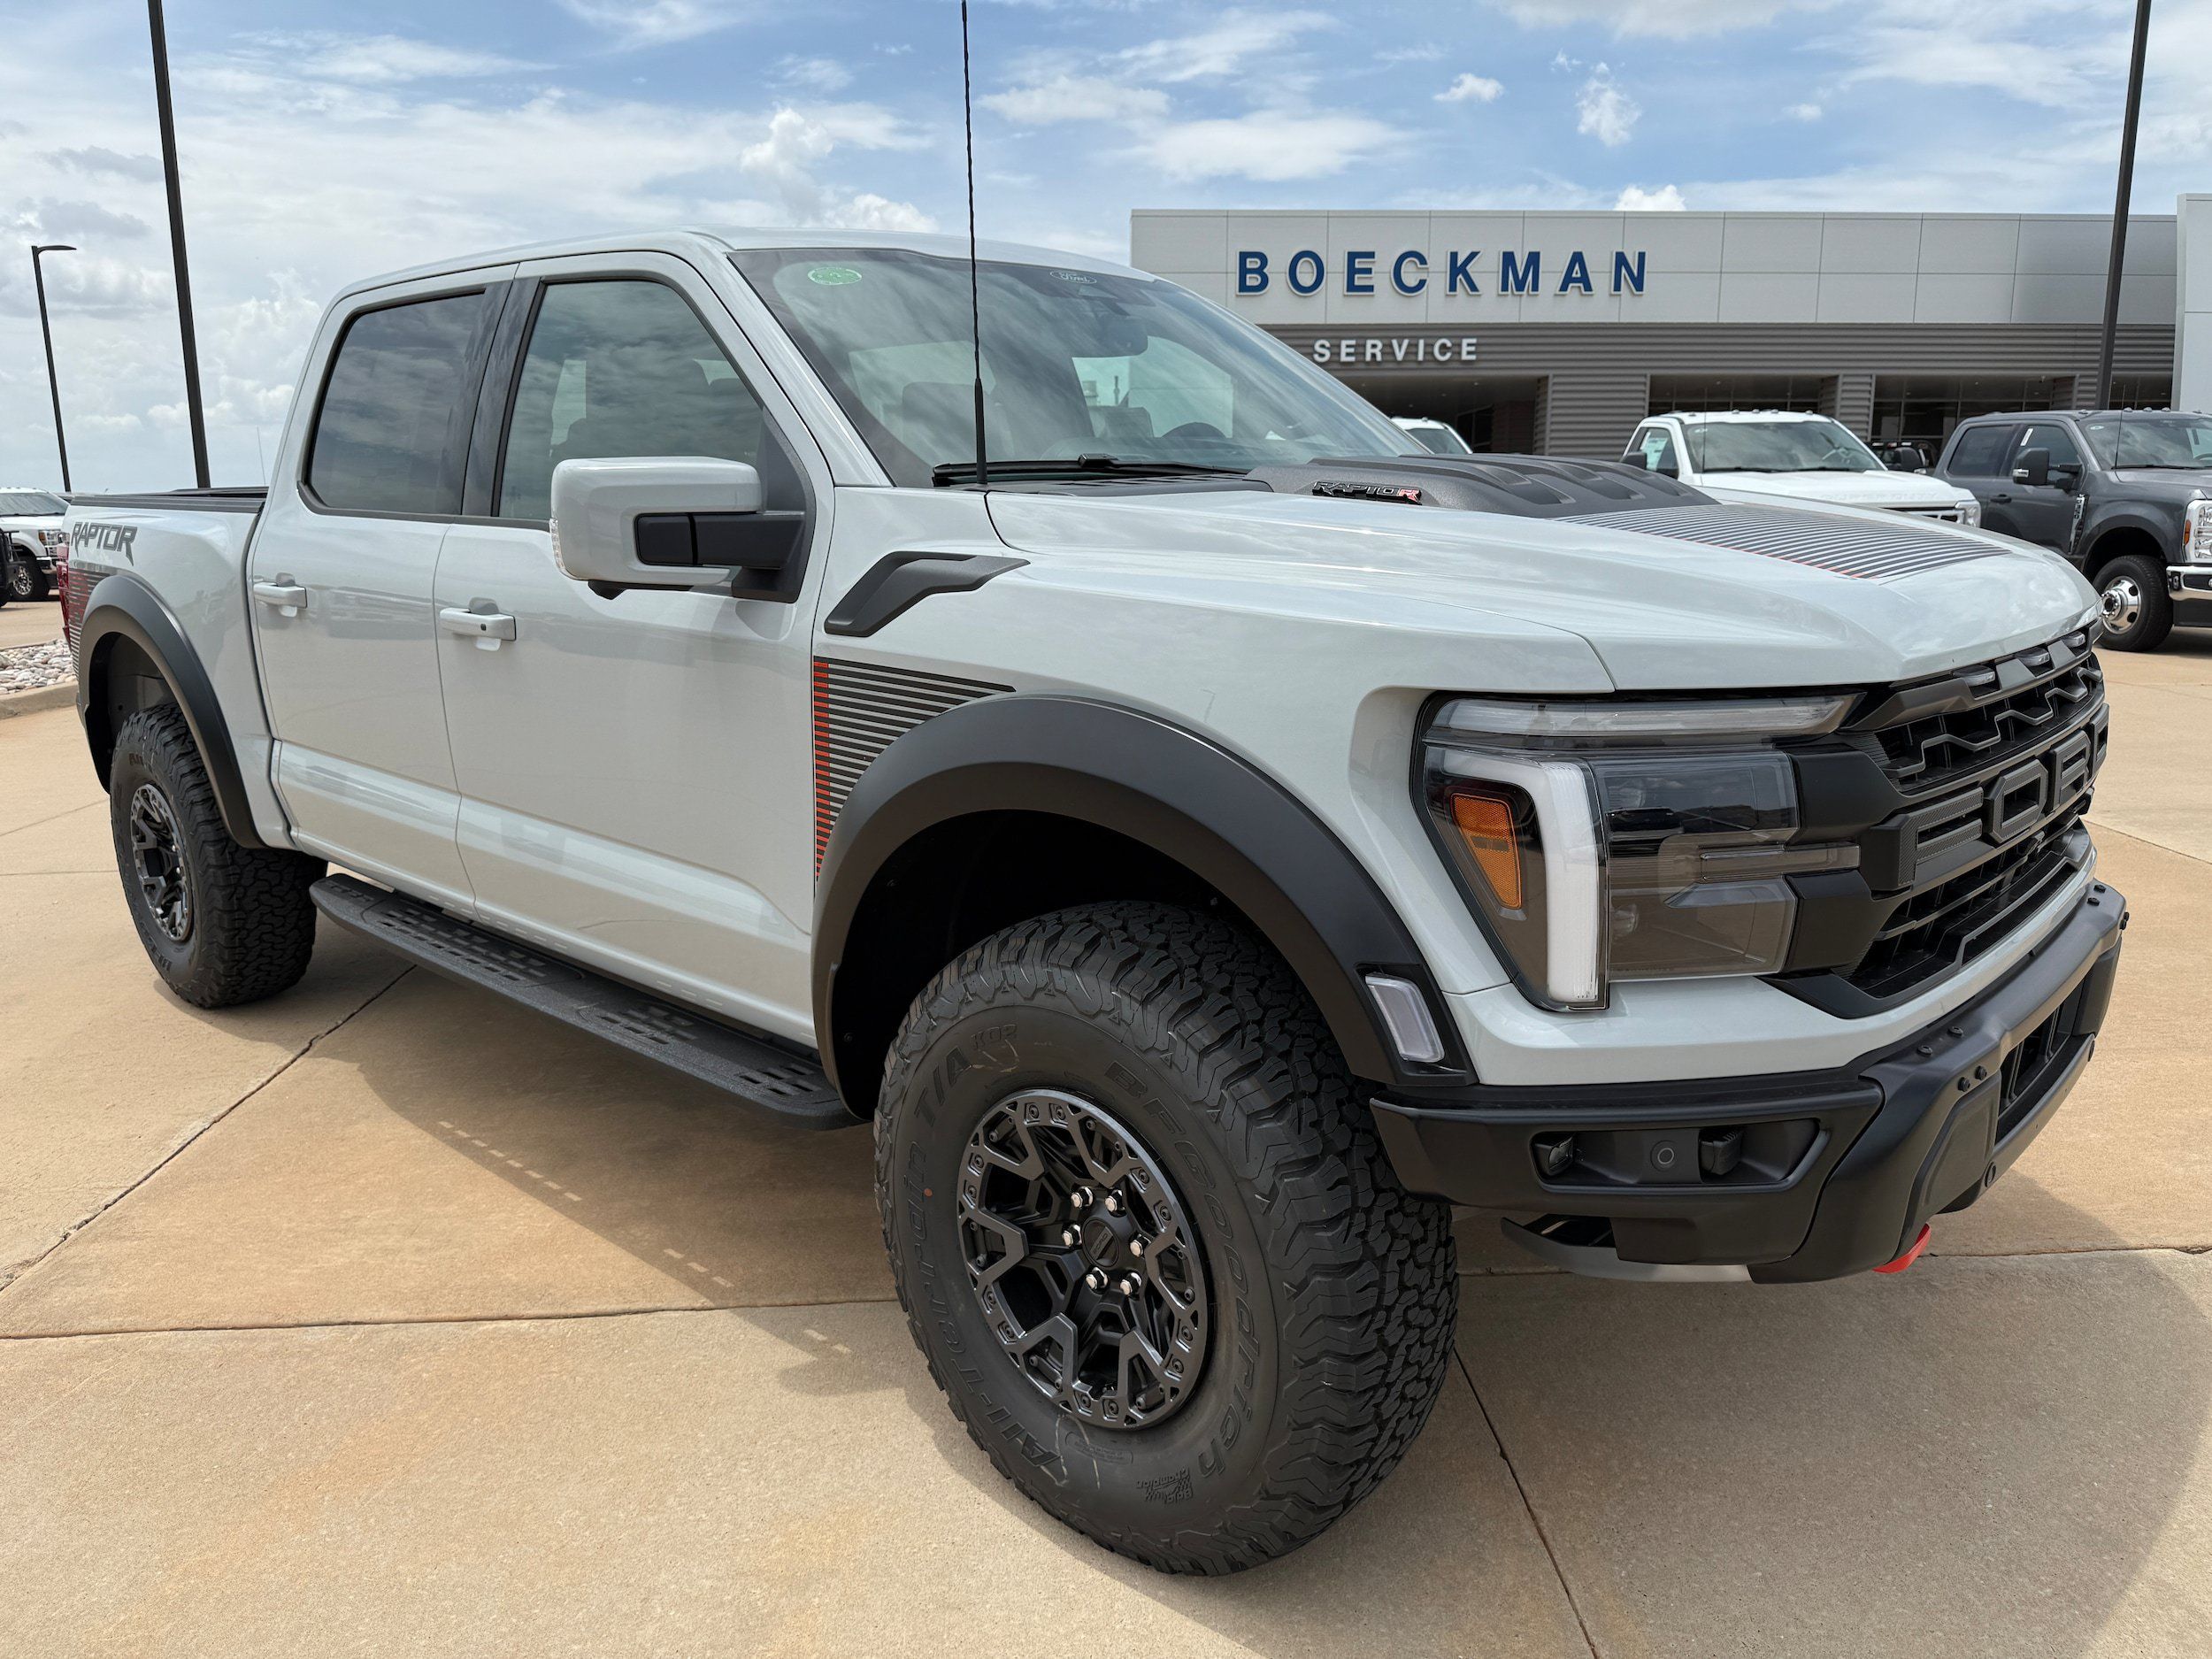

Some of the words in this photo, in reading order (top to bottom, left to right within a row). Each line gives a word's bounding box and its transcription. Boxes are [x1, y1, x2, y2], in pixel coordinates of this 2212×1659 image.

[1236, 250, 1647, 296] BOECKMAN
[1313, 338, 1479, 363] SERVICE
[1312, 481, 1422, 504] RAPTOR
[71, 521, 138, 567] RAPTOR
[1888, 703, 2110, 887] FORD
